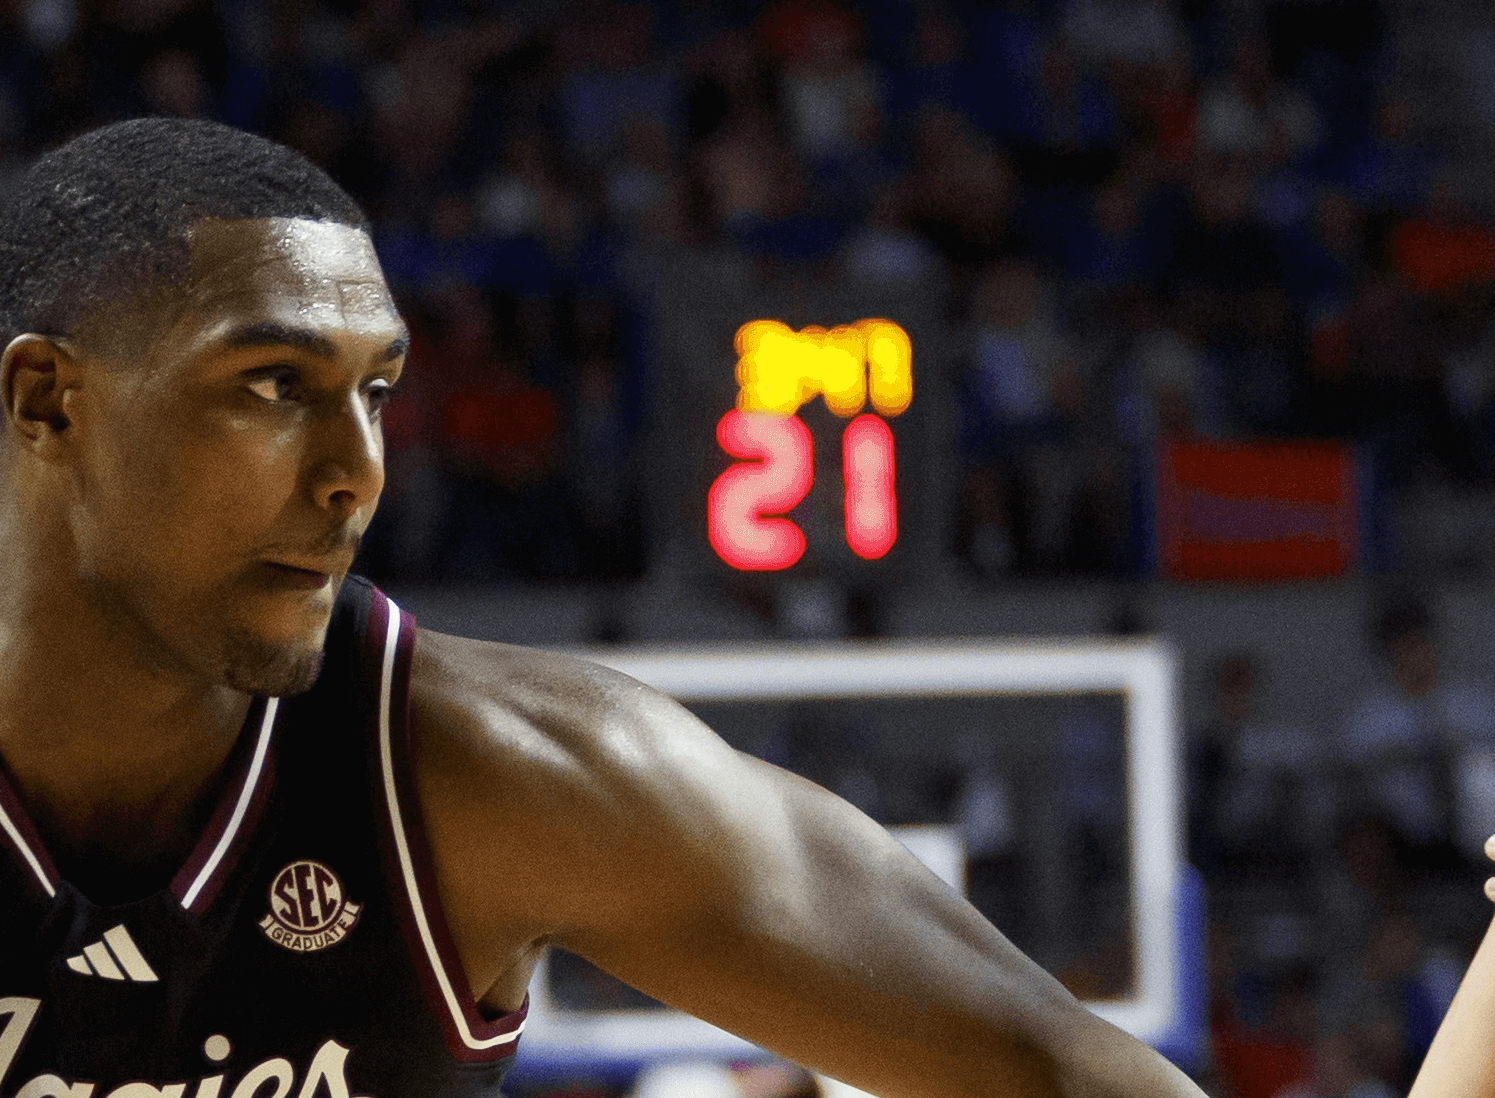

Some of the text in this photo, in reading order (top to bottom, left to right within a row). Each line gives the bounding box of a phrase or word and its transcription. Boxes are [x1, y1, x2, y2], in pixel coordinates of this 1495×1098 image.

[707, 408, 897, 571] 21
[274, 863, 338, 927] SEC
[270, 917, 350, 951] GRADUATE
